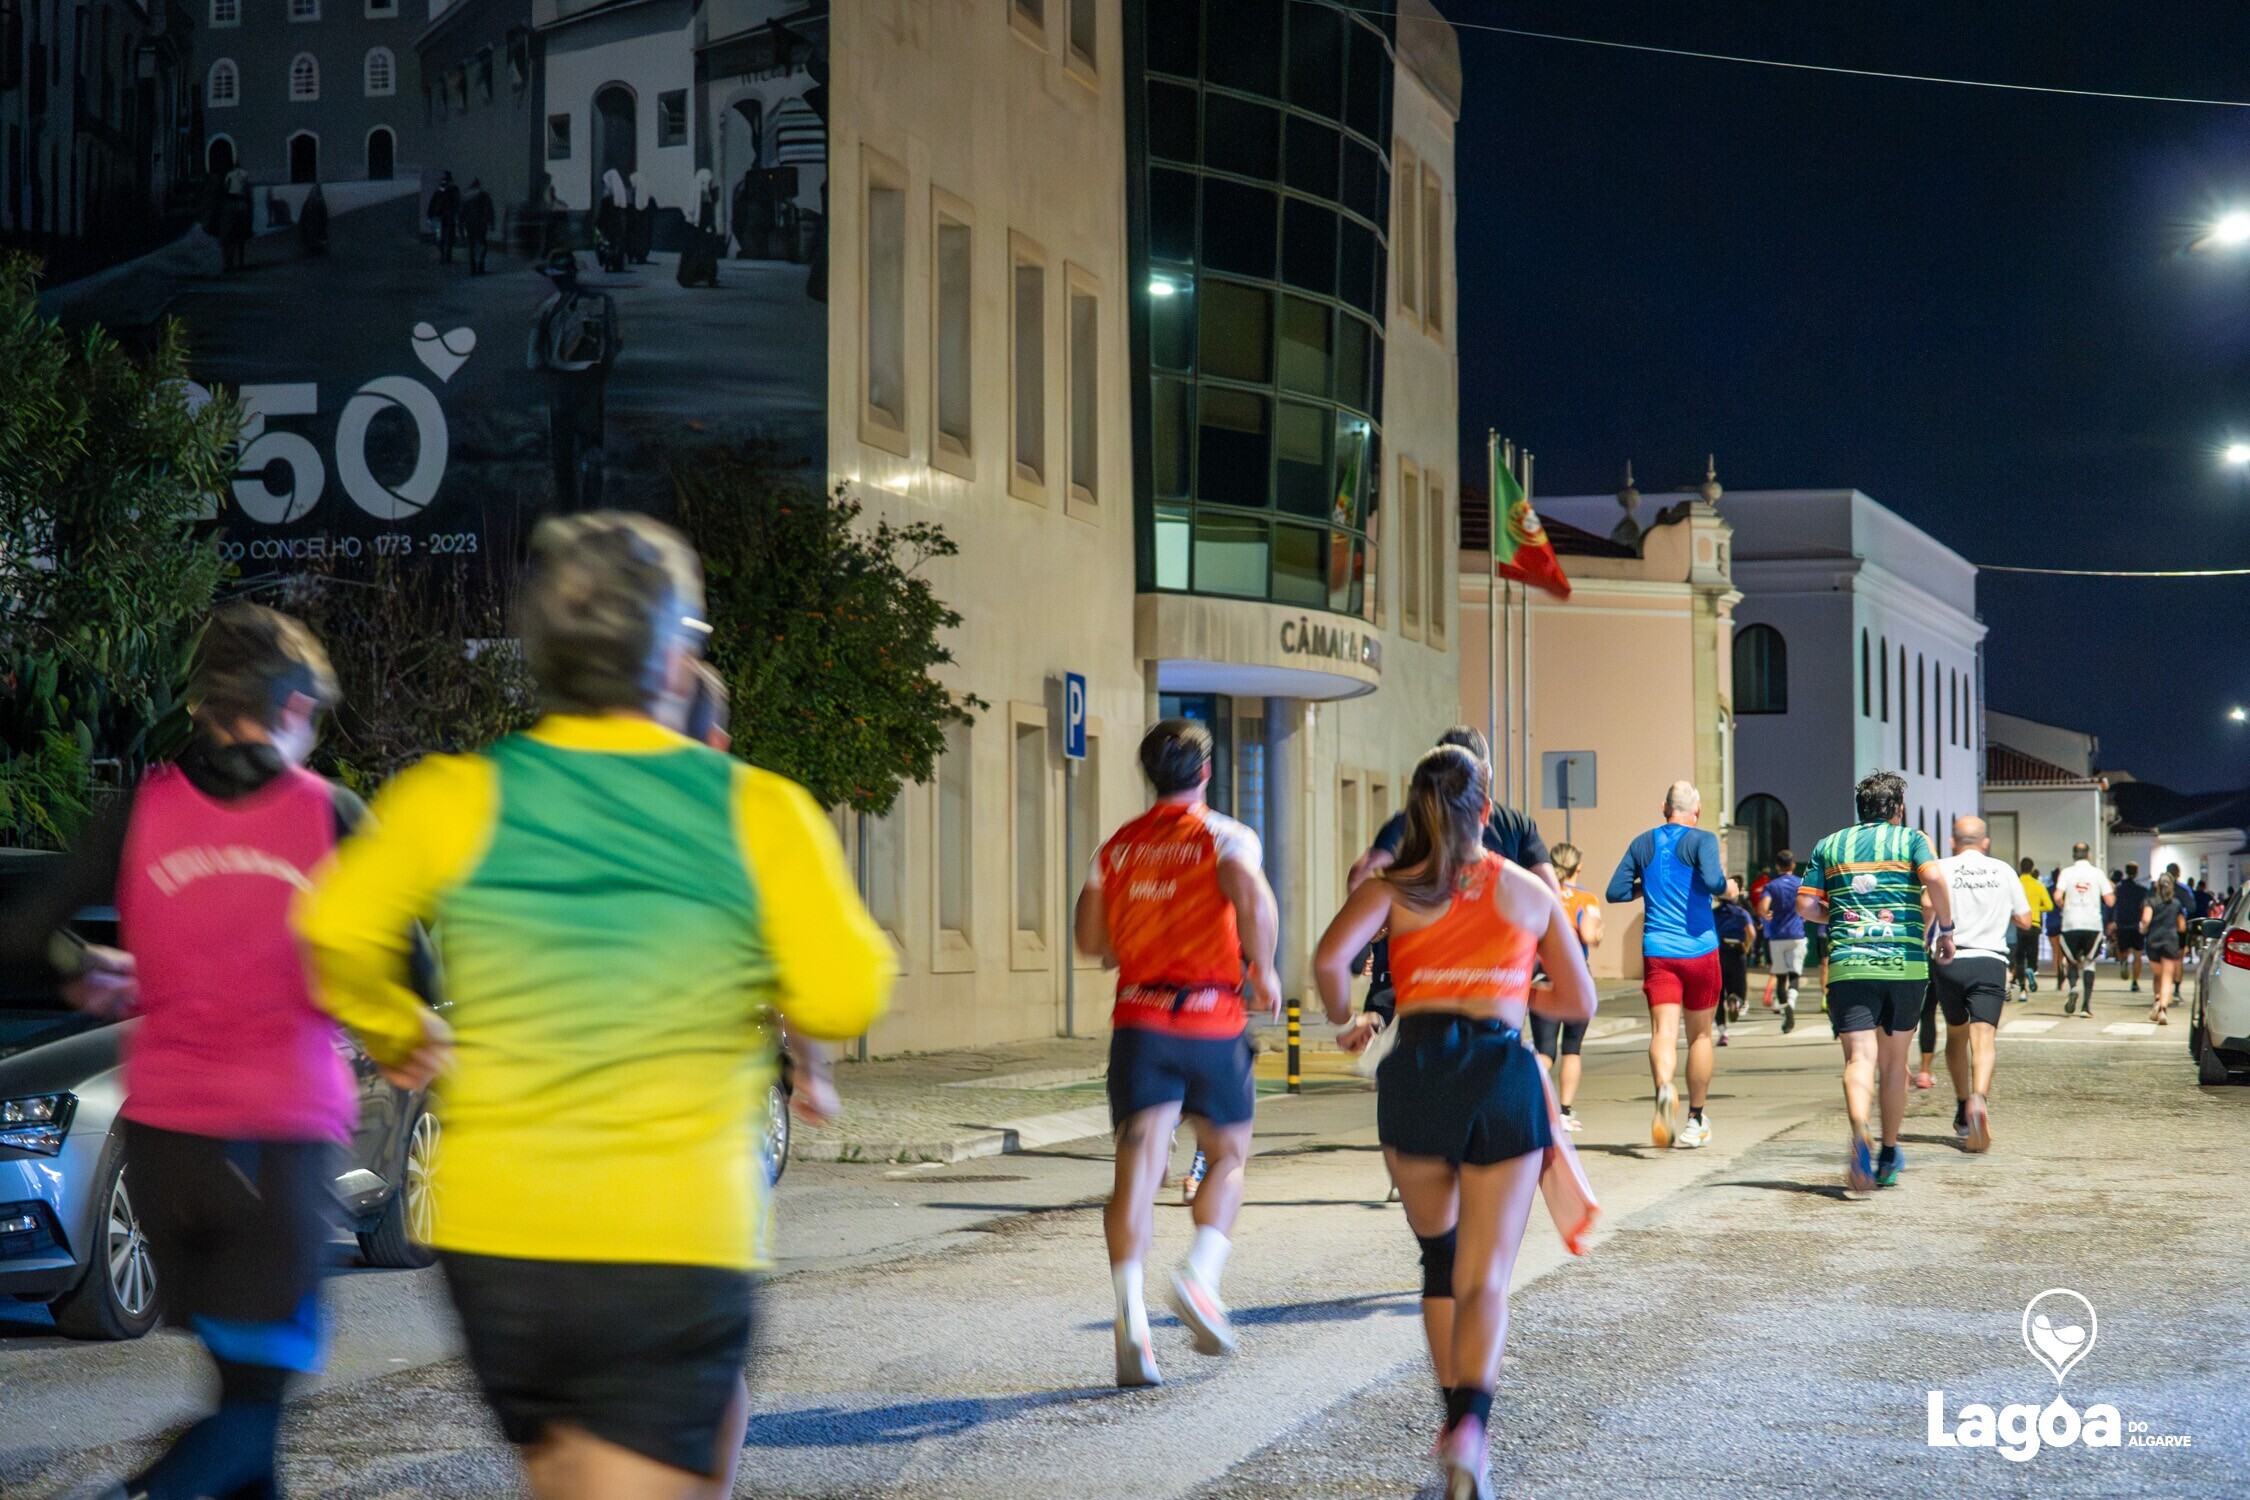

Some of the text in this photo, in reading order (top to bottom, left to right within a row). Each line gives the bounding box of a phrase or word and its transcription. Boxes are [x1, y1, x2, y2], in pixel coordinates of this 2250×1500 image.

[250, 537, 361, 560] CONCELHO
[1069, 679, 1083, 748] P
[1868, 925, 1895, 942] CA
